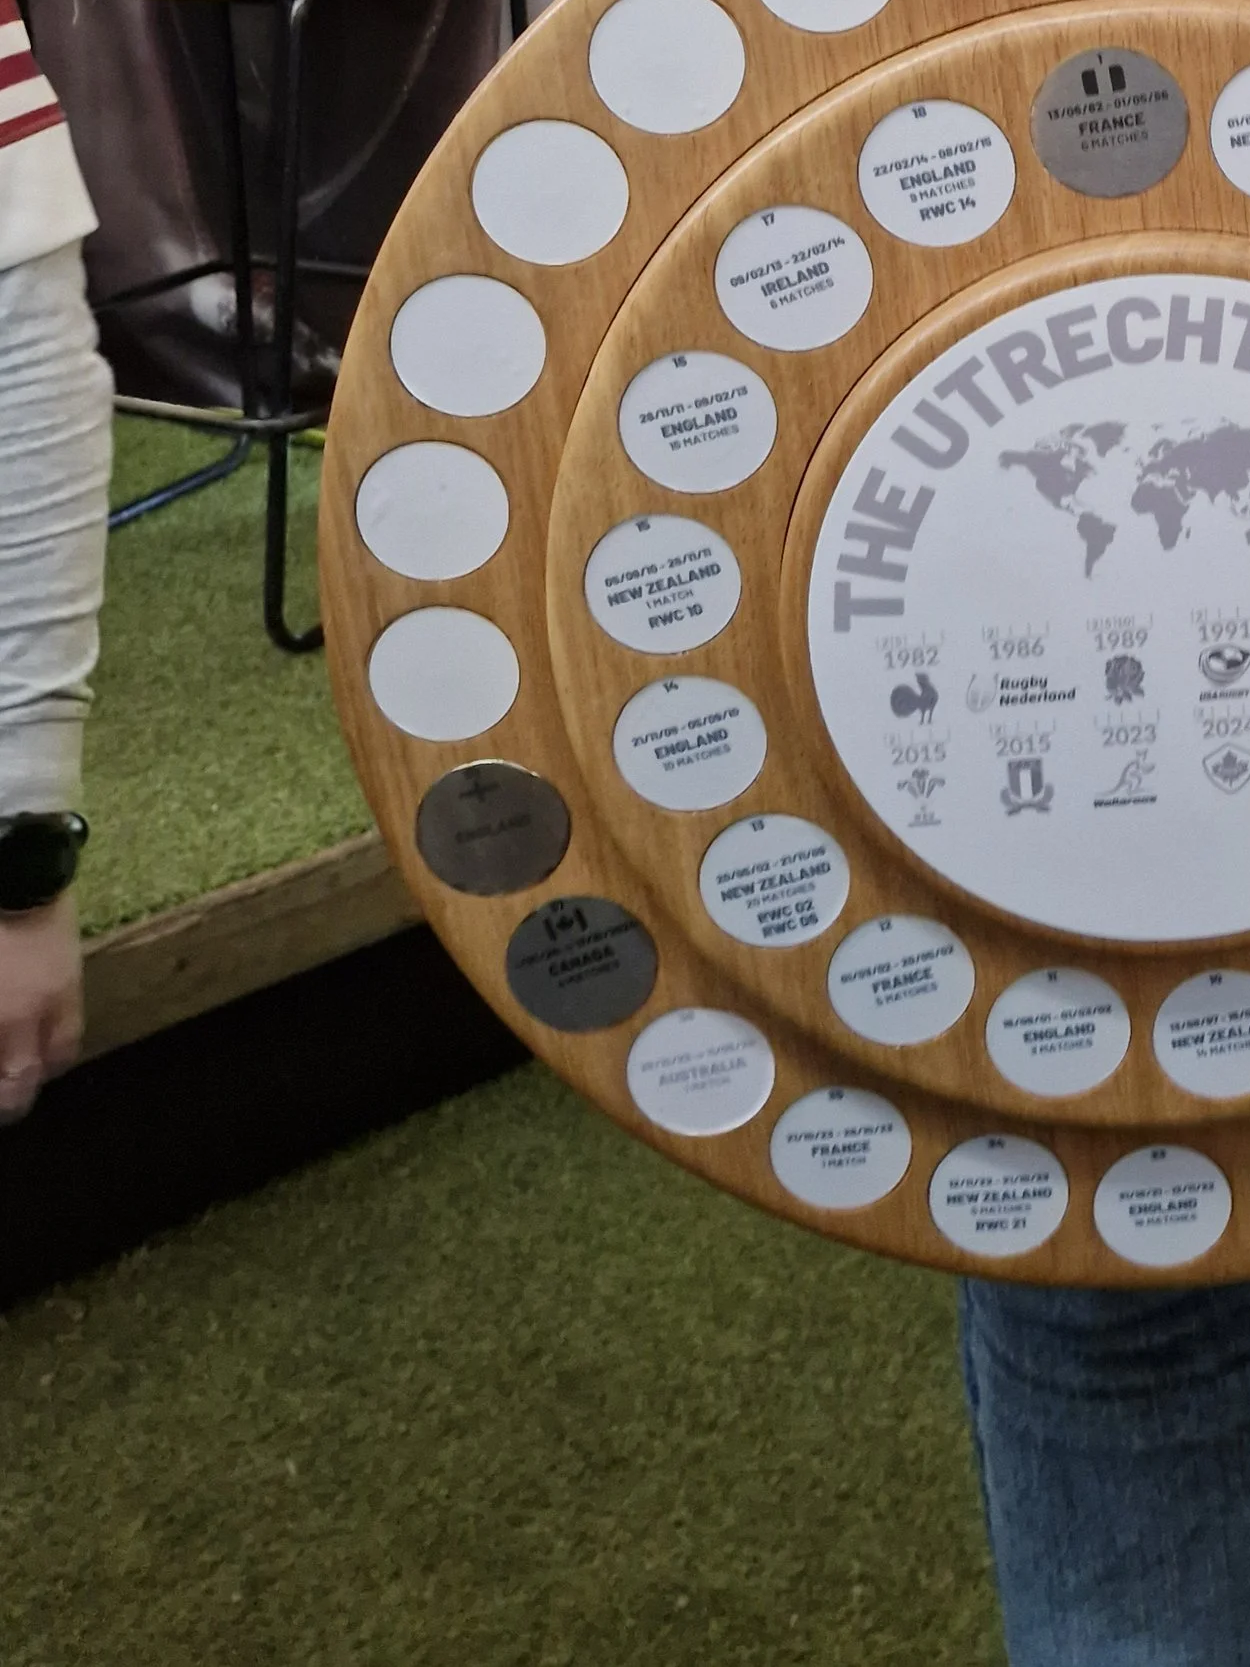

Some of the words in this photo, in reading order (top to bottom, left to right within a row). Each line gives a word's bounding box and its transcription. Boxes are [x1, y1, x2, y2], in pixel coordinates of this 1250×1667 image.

[912, 108, 927, 119] 18
[1078, 112, 1145, 135] FRANCE
[1091, 130, 1148, 149] MATCHES
[900, 161, 976, 190] ENGLAND
[919, 178, 976, 200] MATCHES
[762, 213, 775, 226] 17
[920, 202, 956, 222] RWC
[960, 196, 976, 210] 14
[761, 262, 830, 296] IRELAND
[779, 278, 834, 307] MATCHES
[660, 408, 738, 438] ENGLAND
[683, 425, 739, 446] MATCHES
[833, 466, 936, 633] THE
[607, 586, 643, 607] NEW
[648, 563, 721, 594] ZEALAND
[652, 589, 694, 608] MATCH
[648, 609, 684, 630] RWC
[687, 604, 703, 617] 10
[1093, 629, 1148, 651] 1989
[1200, 620, 1250, 642] 1991
[884, 647, 939, 669] 1982
[989, 638, 1045, 660] 1986
[663, 681, 678, 694] 14
[1000, 676, 1048, 690] Rugby
[999, 688, 1076, 706] Nederland
[655, 728, 728, 760] ENGLAND
[1102, 723, 1158, 747] 2023
[676, 746, 731, 768] MATCHES
[892, 741, 947, 765] 2015
[752, 820, 765, 832] 13
[720, 881, 756, 902] NEW
[759, 861, 831, 891] ZEALAND
[761, 883, 816, 906] MATCHES
[757, 905, 792, 924] RWC
[796, 900, 815, 914] 02
[762, 922, 797, 938] RWC
[872, 966, 934, 994] FRANCE
[1024, 1022, 1095, 1044] ENGLAND
[1171, 1030, 1205, 1050] NEW
[812, 1140, 870, 1158] FRANCE
[946, 1192, 979, 1205] NEW
[983, 1188, 1052, 1202] ZEALAND
[1129, 1198, 1197, 1216] ENGLAND
